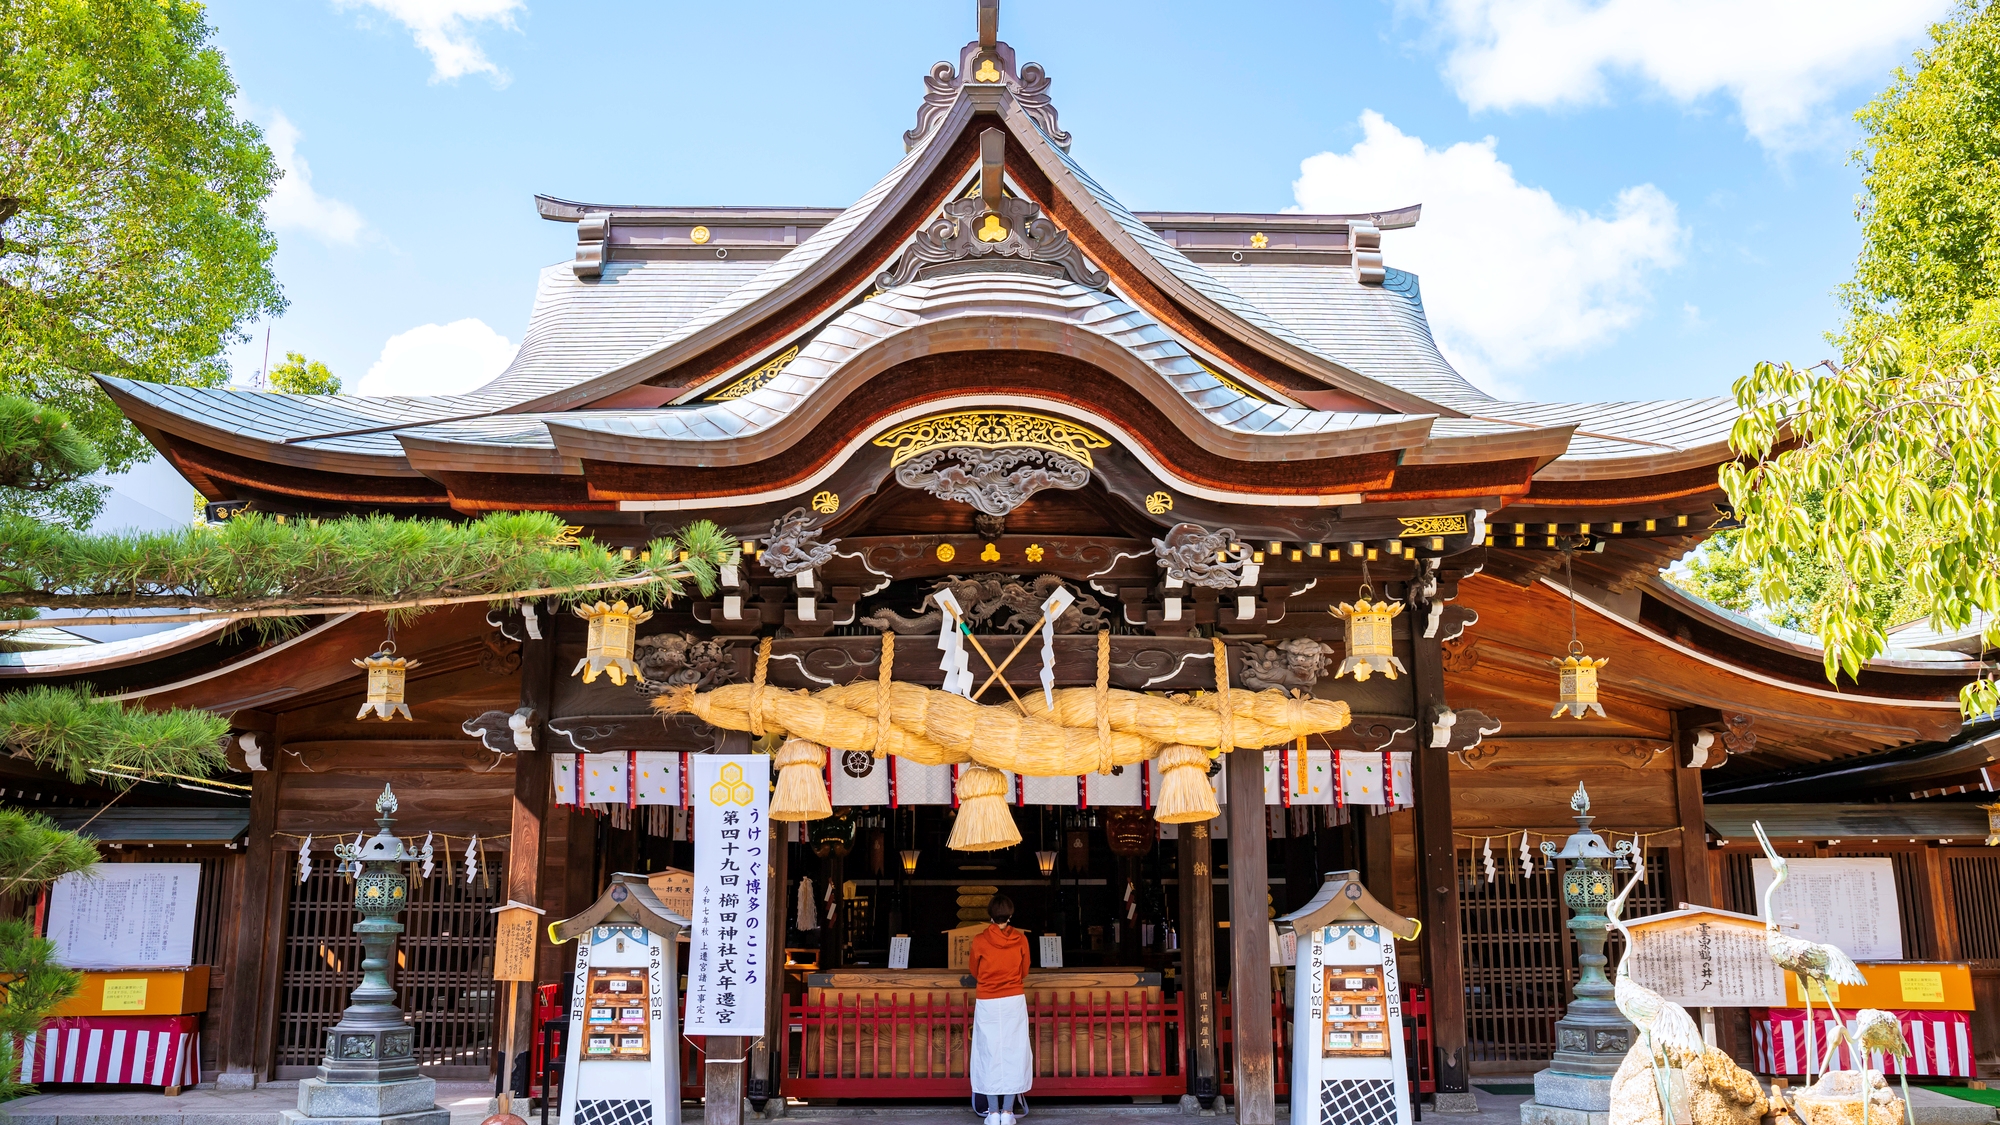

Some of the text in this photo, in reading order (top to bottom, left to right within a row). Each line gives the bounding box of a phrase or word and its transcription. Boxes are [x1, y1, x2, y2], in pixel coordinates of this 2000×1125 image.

[1192, 825, 1208, 876] 奉納
[701, 886, 710, 936] 令和七年秋
[716, 810, 740, 1024] 第四十九回 櫛田神社式年遷宮
[745, 808, 762, 984] うけつぐ博多のこころ
[572, 946, 588, 1020] おみくじ100円
[650, 946, 662, 1020] おみくじ100円
[1311, 946, 1322, 1019] おみくじ100円
[1383, 944, 1400, 1018] おみくじ100円
[1696, 923, 1712, 991] 霊泉鶴の井戸
